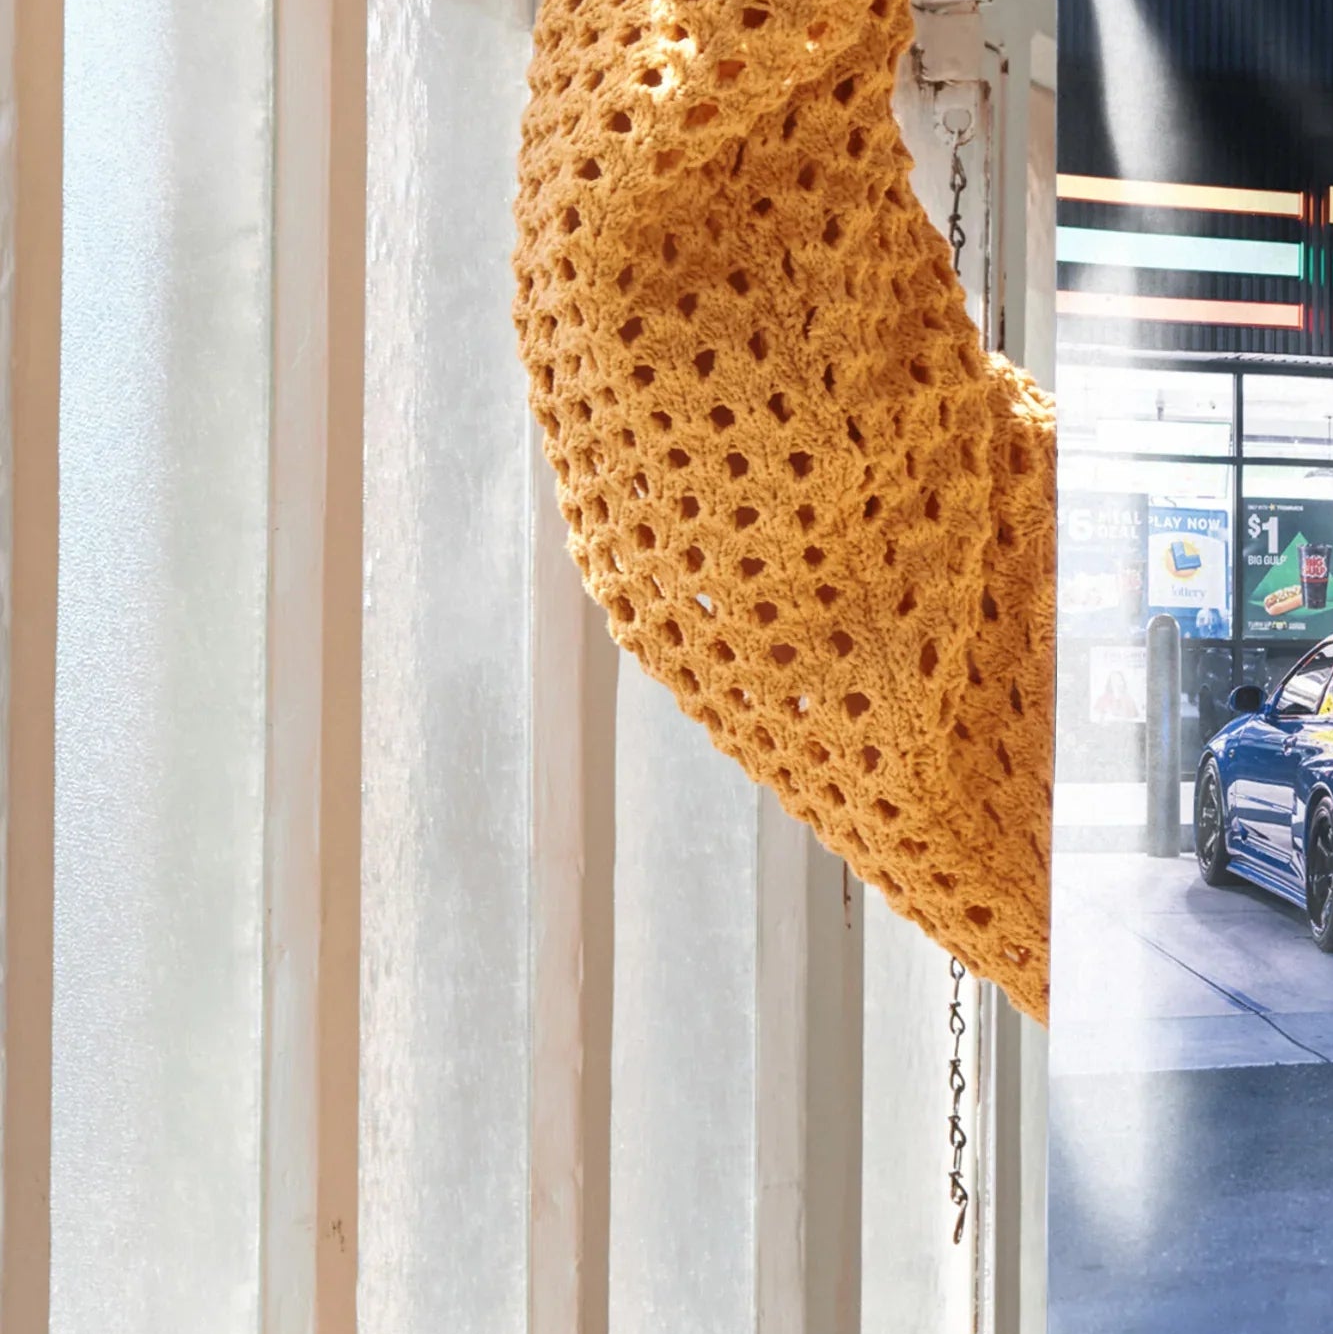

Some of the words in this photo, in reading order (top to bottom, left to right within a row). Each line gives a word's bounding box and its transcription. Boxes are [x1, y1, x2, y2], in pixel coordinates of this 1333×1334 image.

[1187, 517, 1221, 531] NOW
[1248, 513, 1279, 554] $1
[1248, 555, 1261, 565] BIG
